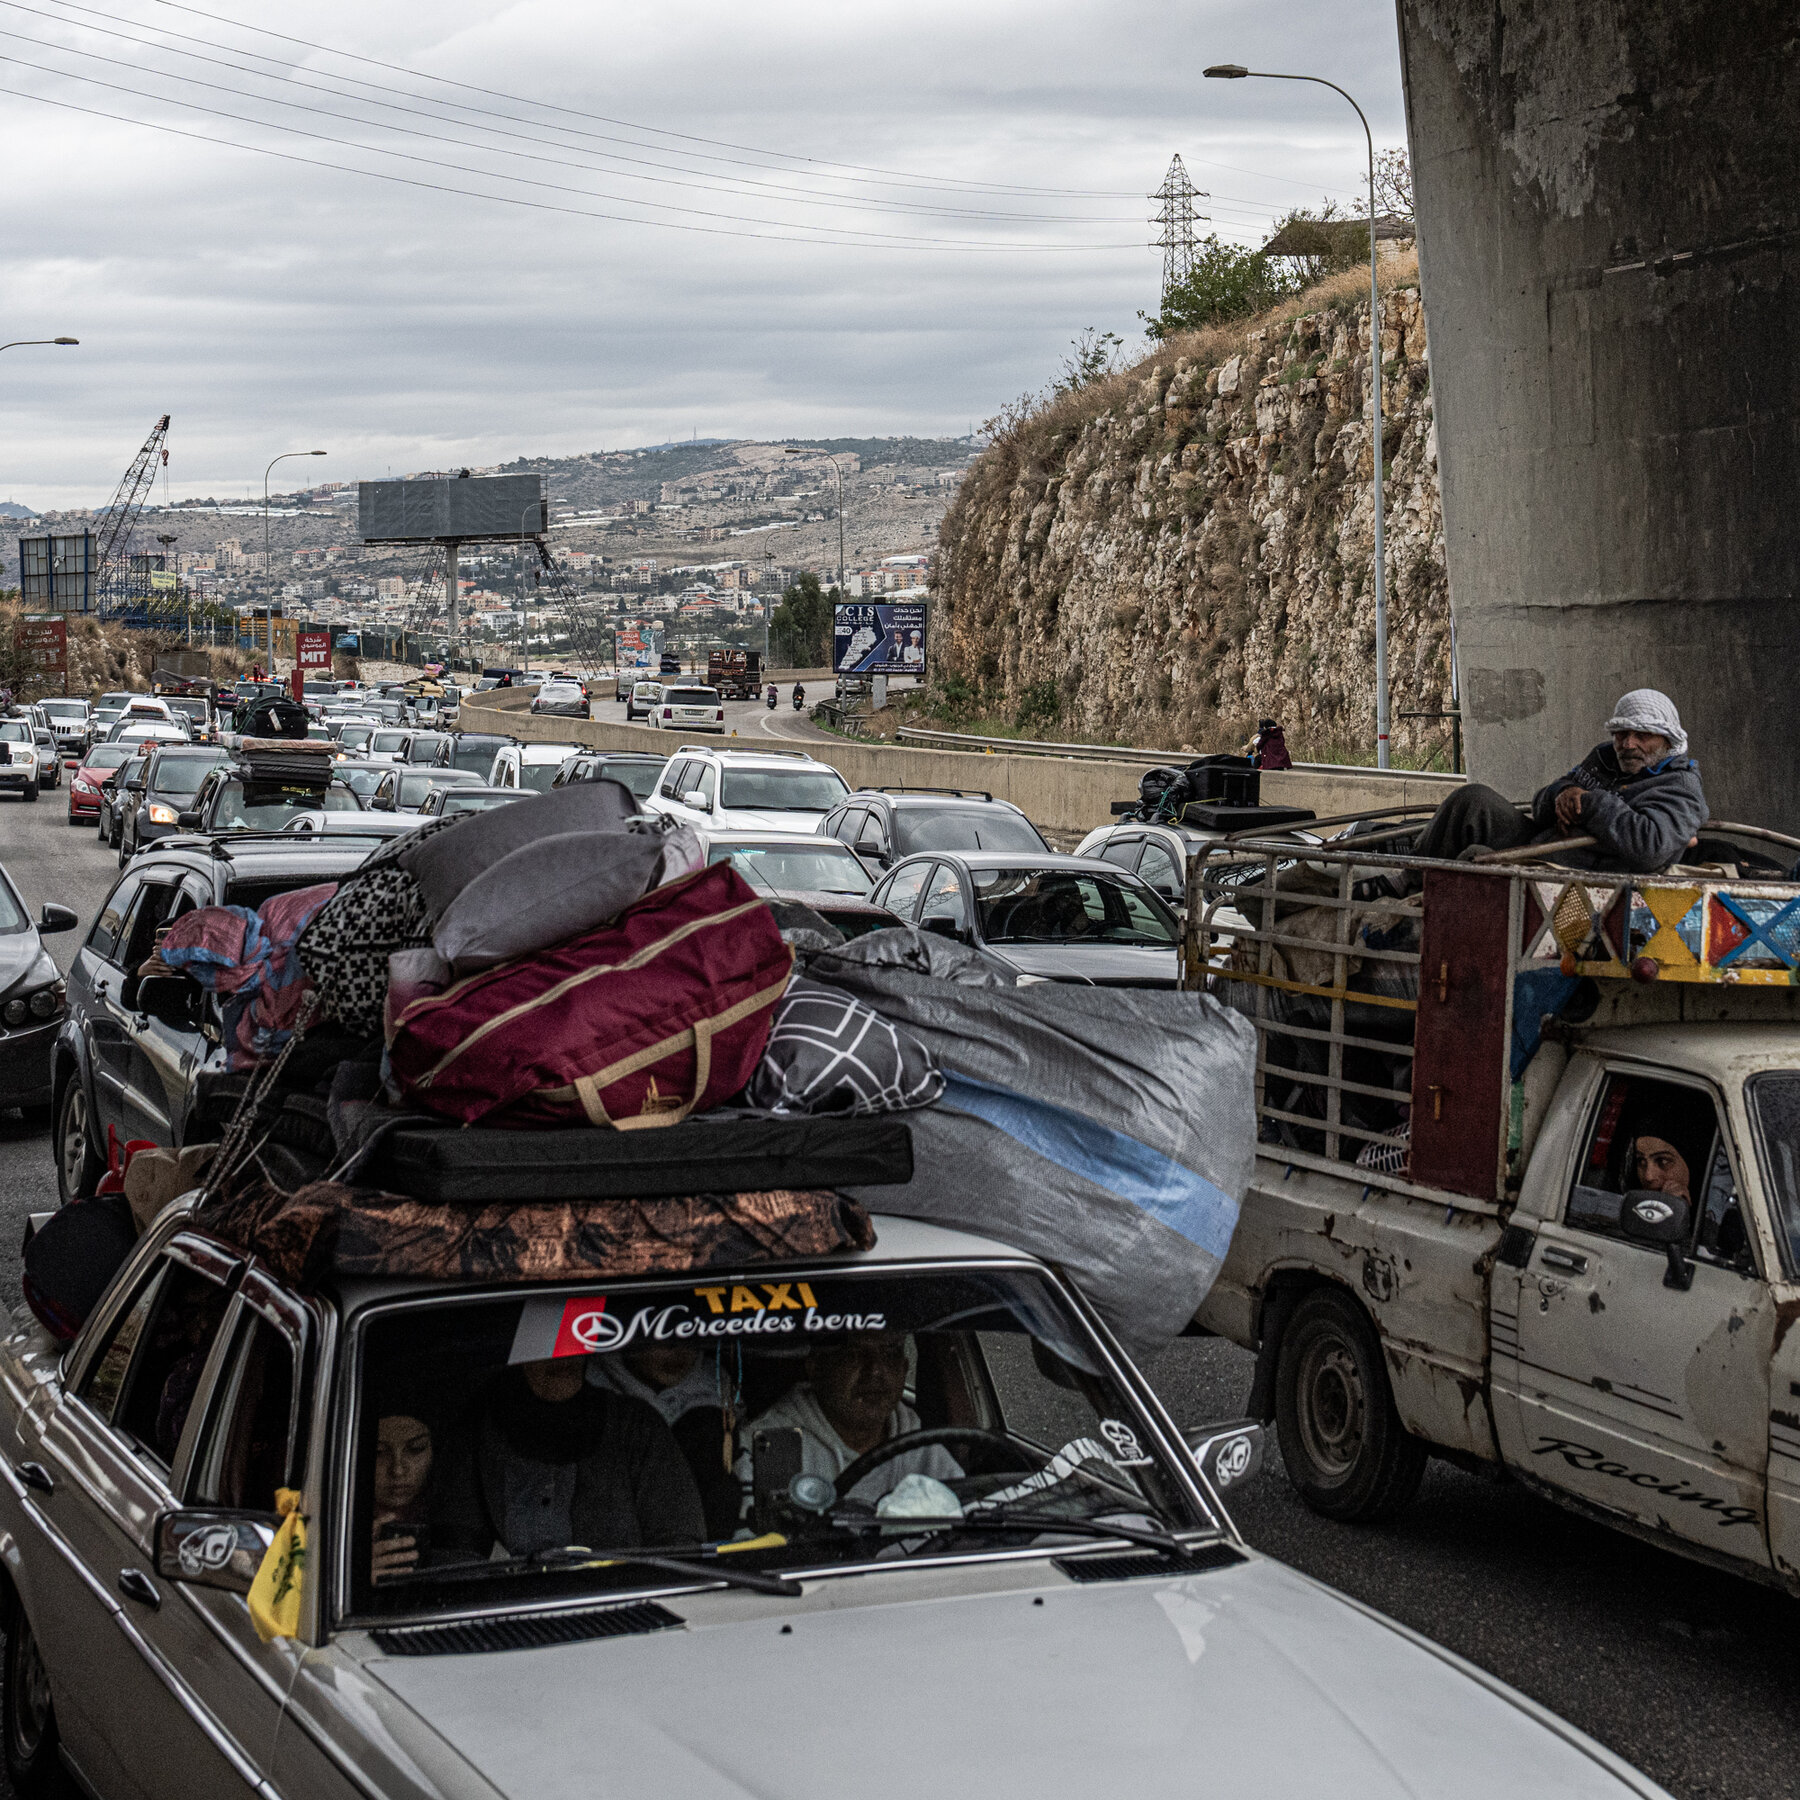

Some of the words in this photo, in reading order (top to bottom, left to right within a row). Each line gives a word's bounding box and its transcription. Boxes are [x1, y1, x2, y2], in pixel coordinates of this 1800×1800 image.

[845, 606, 874, 616] CIS
[300, 651, 326, 662] MIT
[694, 1282, 819, 1315] TAXI
[585, 1304, 796, 1353] Mercedes
[804, 1307, 887, 1332] benz
[1531, 1436, 1761, 1527] Racing
